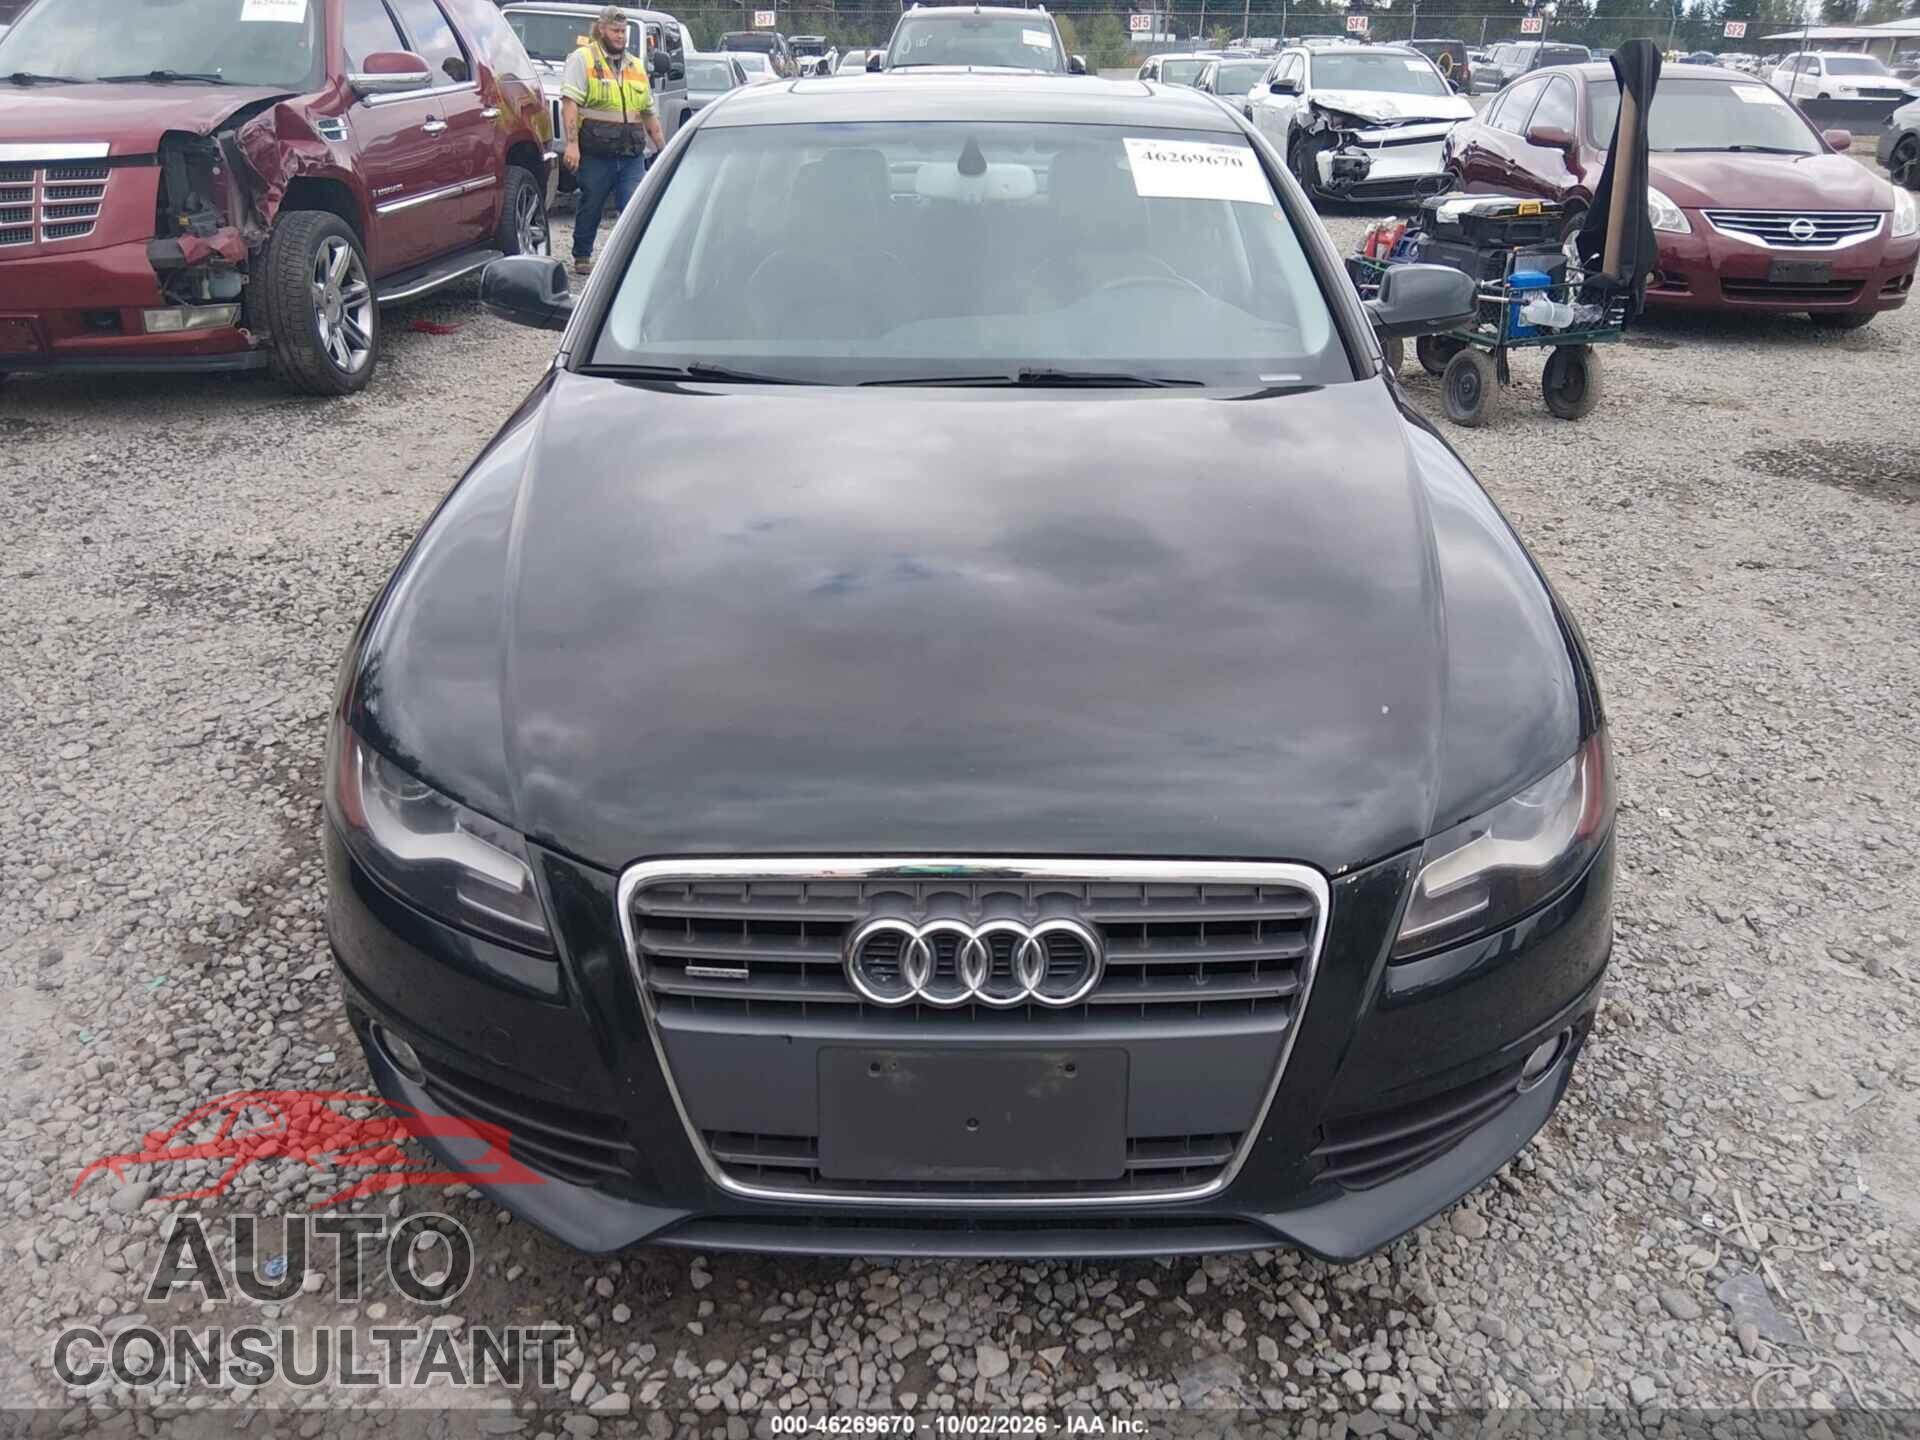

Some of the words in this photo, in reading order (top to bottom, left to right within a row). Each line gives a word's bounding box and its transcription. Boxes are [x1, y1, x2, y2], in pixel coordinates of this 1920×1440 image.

[1132, 16, 1149, 28] SF5
[1349, 18, 1366, 29] SF4
[1524, 20, 1541, 31] SF3
[1727, 23, 1744, 35] SF2
[1142, 151, 1243, 167] 46269670
